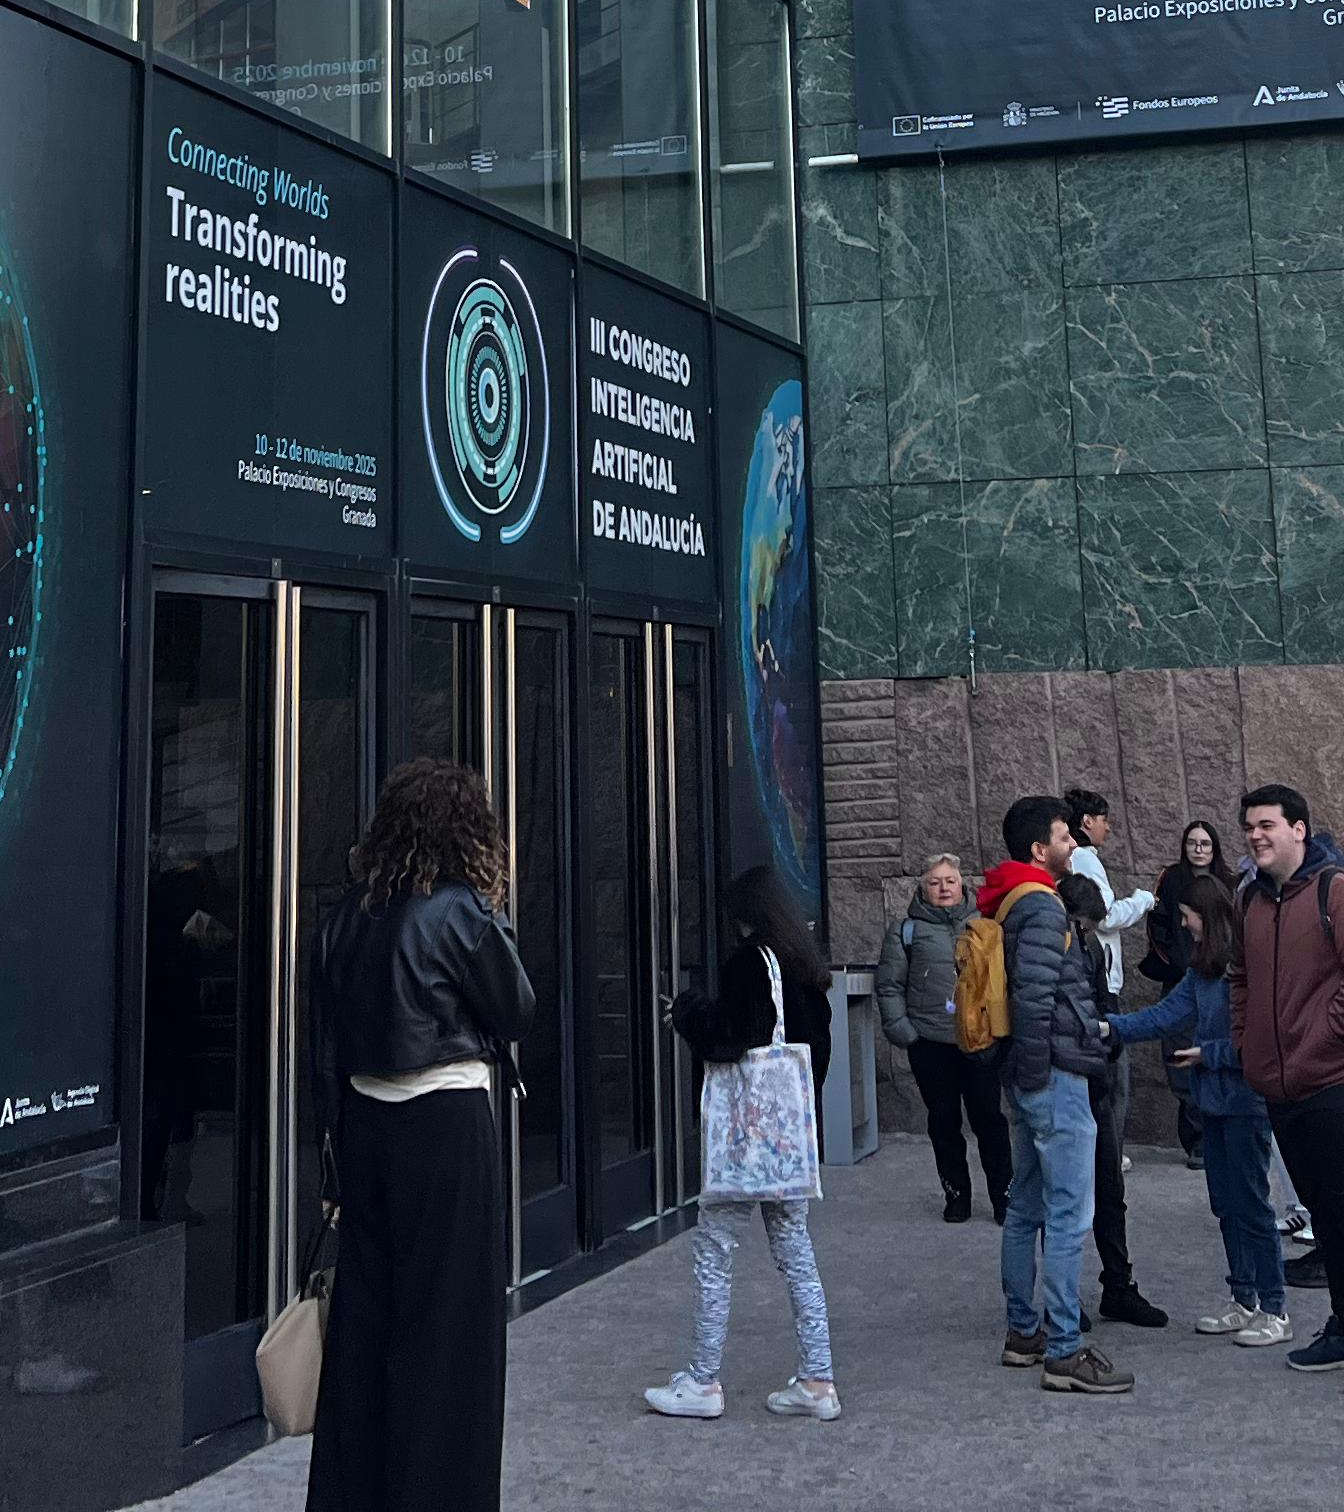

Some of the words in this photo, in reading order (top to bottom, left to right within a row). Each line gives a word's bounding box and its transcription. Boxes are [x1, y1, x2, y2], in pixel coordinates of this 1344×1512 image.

[1132, 99, 1169, 111] Fondos
[1171, 95, 1218, 108] Europeos
[168, 127, 269, 206] Connecting
[274, 167, 330, 219] Worlds
[166, 186, 347, 304] Transforming
[166, 263, 280, 332] realities
[590, 317, 606, 356] III
[609, 325, 691, 387] CONGRESO
[590, 377, 695, 444] INTELIGENCIA
[238, 459, 272, 485] Palacio
[273, 466, 328, 494] Exposiciones
[328, 479, 335, 499] y
[335, 477, 376, 504] Congresos
[255, 433, 268, 456] 10
[276, 437, 288, 459] 12
[289, 438, 302, 462] de
[303, 445, 354, 472] noviembre
[355, 453, 376, 477] 2025
[592, 439, 677, 494] ARTIFICIAL
[343, 505, 376, 528] Granada
[593, 499, 616, 539] DE
[619, 512, 705, 557] ANDALUCÍA
